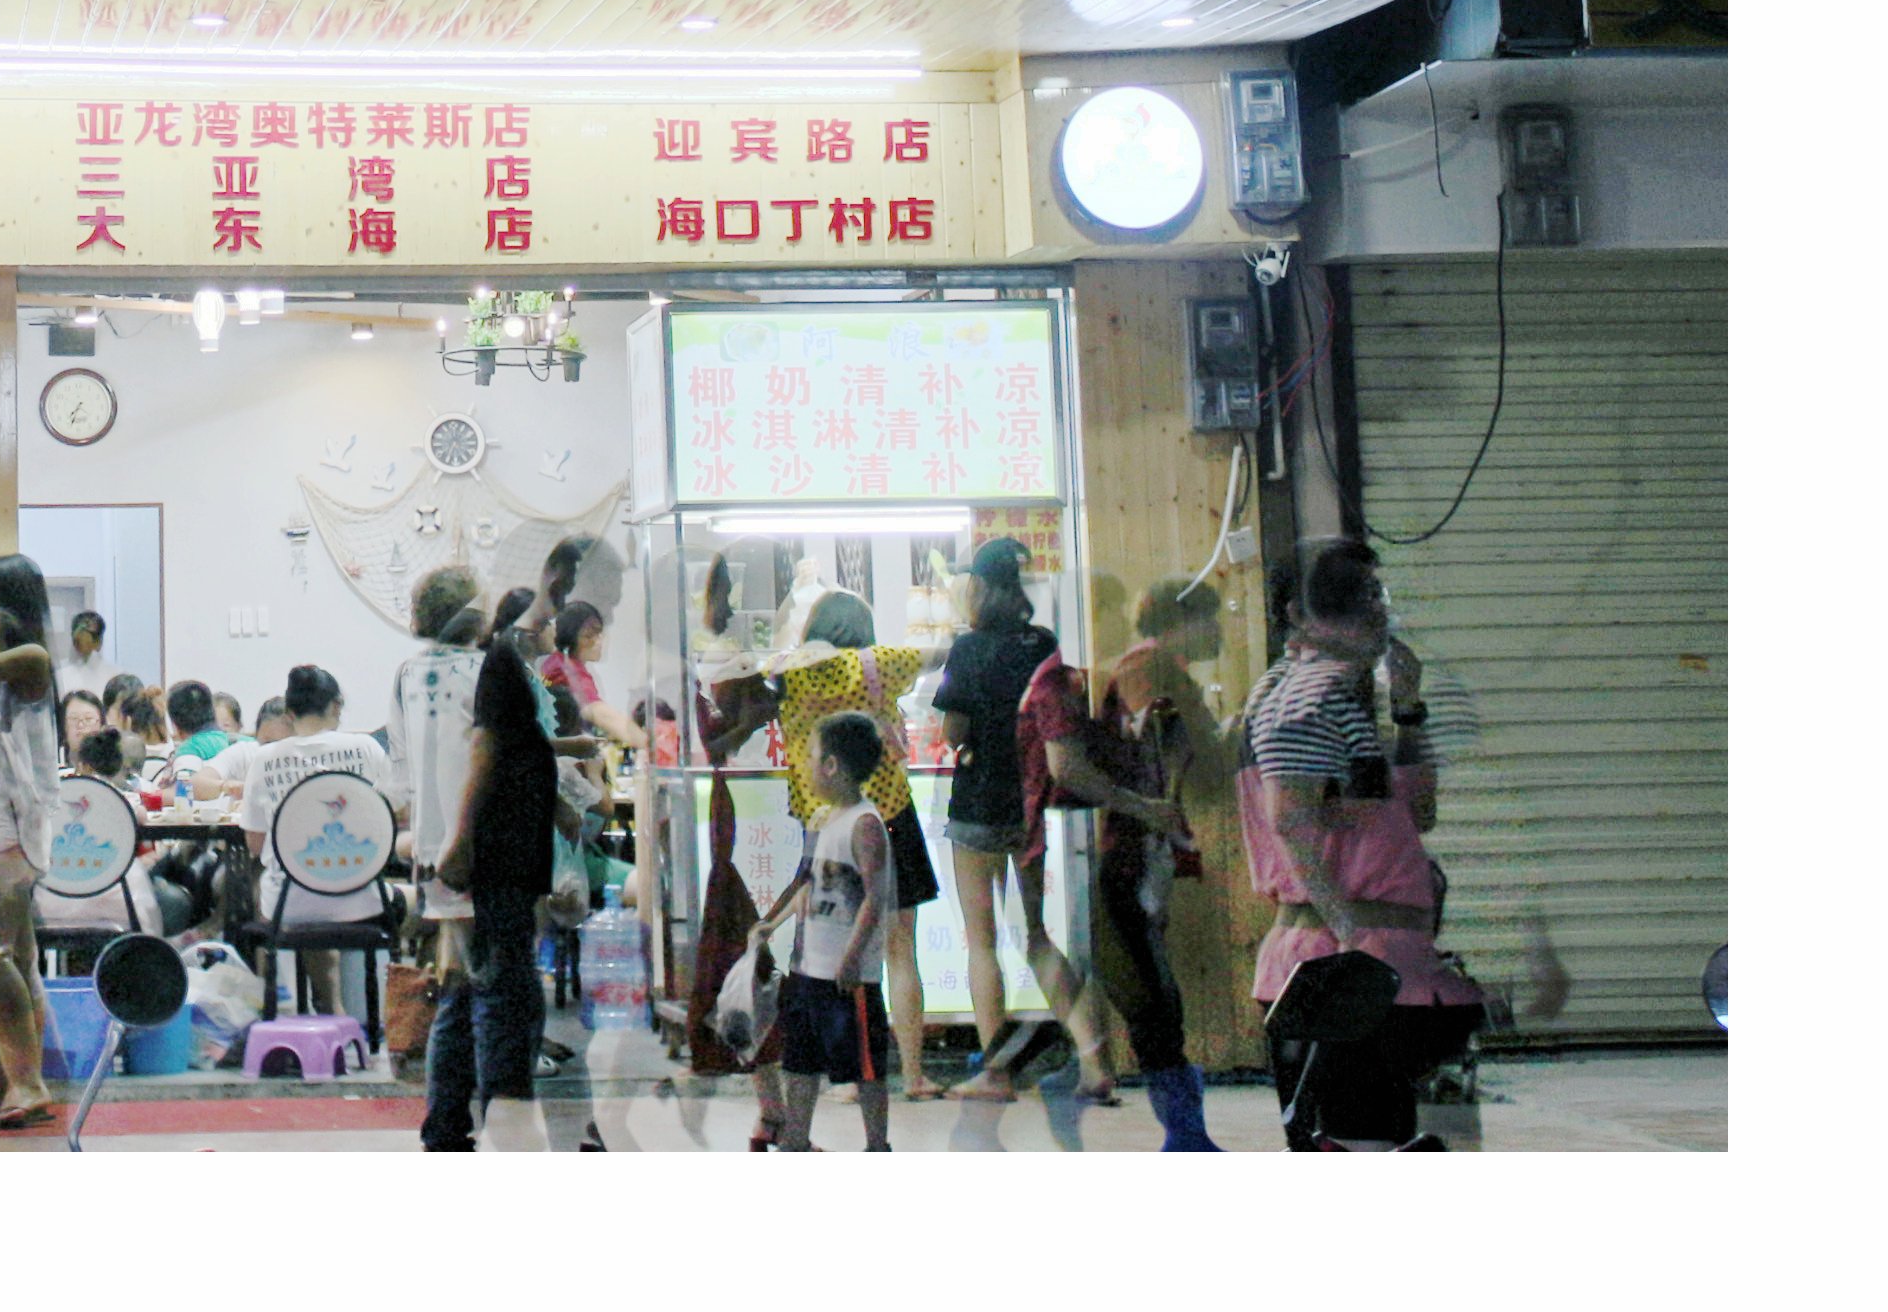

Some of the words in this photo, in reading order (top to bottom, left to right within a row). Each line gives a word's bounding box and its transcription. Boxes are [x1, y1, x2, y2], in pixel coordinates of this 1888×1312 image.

[76, 100, 532, 150] 亚龙湾奥特莱斯店
[654, 117, 931, 165] 迎宾路店
[77, 154, 532, 202] 三亚湾店
[77, 206, 534, 254] 大东海店
[656, 196, 935, 244] 海口丁村店
[688, 362, 1041, 408] 椰奶清补凉
[691, 406, 1043, 452] 冰淇淋清补凉
[693, 451, 1046, 496] 冰沙清补凉
